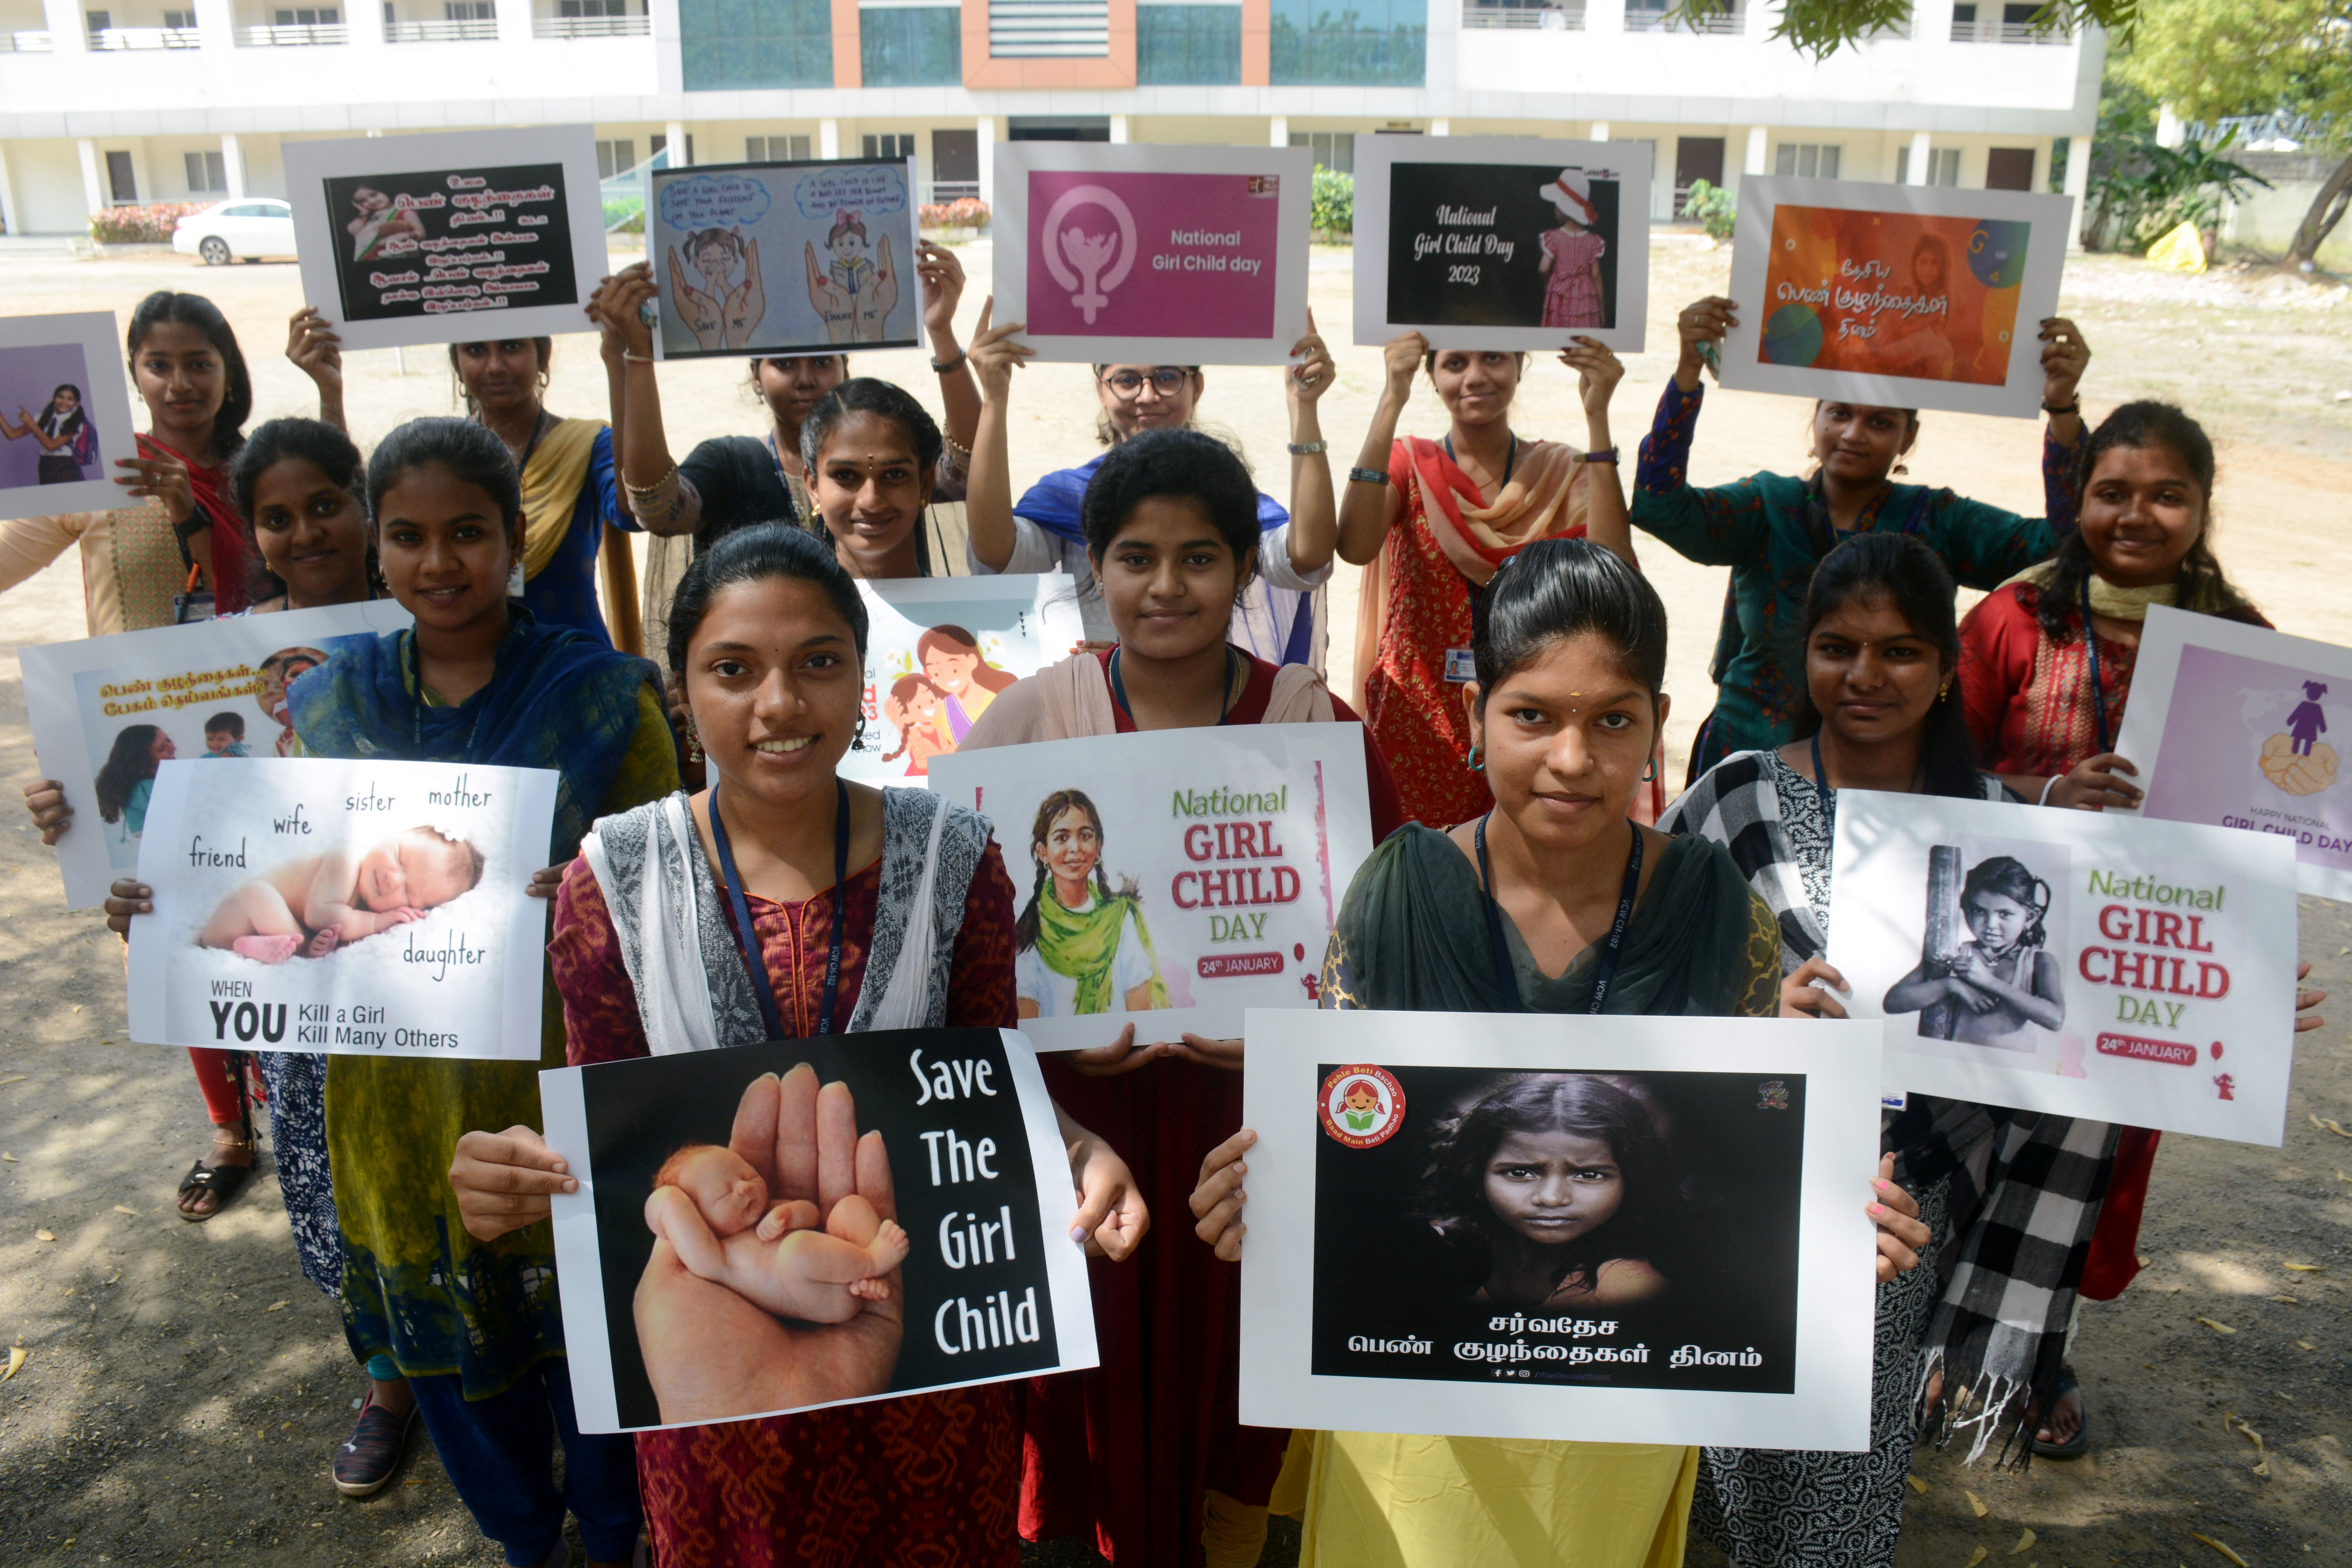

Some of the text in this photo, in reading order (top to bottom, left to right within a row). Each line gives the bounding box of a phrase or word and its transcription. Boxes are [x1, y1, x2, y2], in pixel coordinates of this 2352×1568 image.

[395, 184, 555, 210] பெண் குழந்தைகள்
[1436, 204, 1497, 226] National
[1171, 230, 1240, 246] National
[1414, 233, 1514, 263] Girl Child Day
[1152, 255, 1261, 276] Girl Child day
[1448, 265, 1481, 286] 2023
[1841, 258, 1891, 282] தேசிய
[1777, 279, 1948, 318] பெண் குழந்தைகள்
[1838, 319, 1877, 340] தினம்
[100, 679, 152, 699] பெண்
[345, 780, 396, 811] sister
[428, 773, 492, 808] mother
[1172, 784, 1287, 817] National
[274, 804, 312, 835] wife
[2250, 807, 2331, 830] HAPPY NATIONAL
[189, 835, 247, 869] friend
[1183, 821, 1283, 862] GIRL
[2318, 835, 2352, 853] DAY
[1171, 865, 1301, 910] CHILD
[2087, 868, 2225, 912] National
[1210, 913, 1267, 942] DAY
[1610, 899, 1631, 949] VCW CH-102
[2098, 905, 2215, 954] GIRL
[403, 929, 486, 982] daughter
[1201, 957, 1278, 975] 24th JANUARY
[828, 963, 838, 986] CH-102
[2078, 946, 2231, 1000] CHILD
[211, 980, 252, 998] WHEN
[1597, 980, 1607, 1000] VCW
[209, 1001, 287, 1043] YOU
[299, 1004, 385, 1024] Kill a Girl
[820, 1018, 829, 1034] VCW
[2116, 994, 2187, 1029] DAY
[298, 1026, 458, 1049] Kill Many Others
[2100, 1036, 2192, 1062] 24th JANUARY
[910, 1049, 998, 1105] Save
[1328, 1067, 1397, 1097] Pehle Beti Bachao
[1326, 1114, 1399, 1145] Baad Main Beti Padhao
[921, 1130, 999, 1186] The
[939, 1205, 1015, 1269] Girl
[934, 1287, 1040, 1356] Child
[1489, 1312, 1619, 1339] சர்வதேச
[1348, 1334, 1762, 1369] பெண் குழந்தைகள் தினம்
